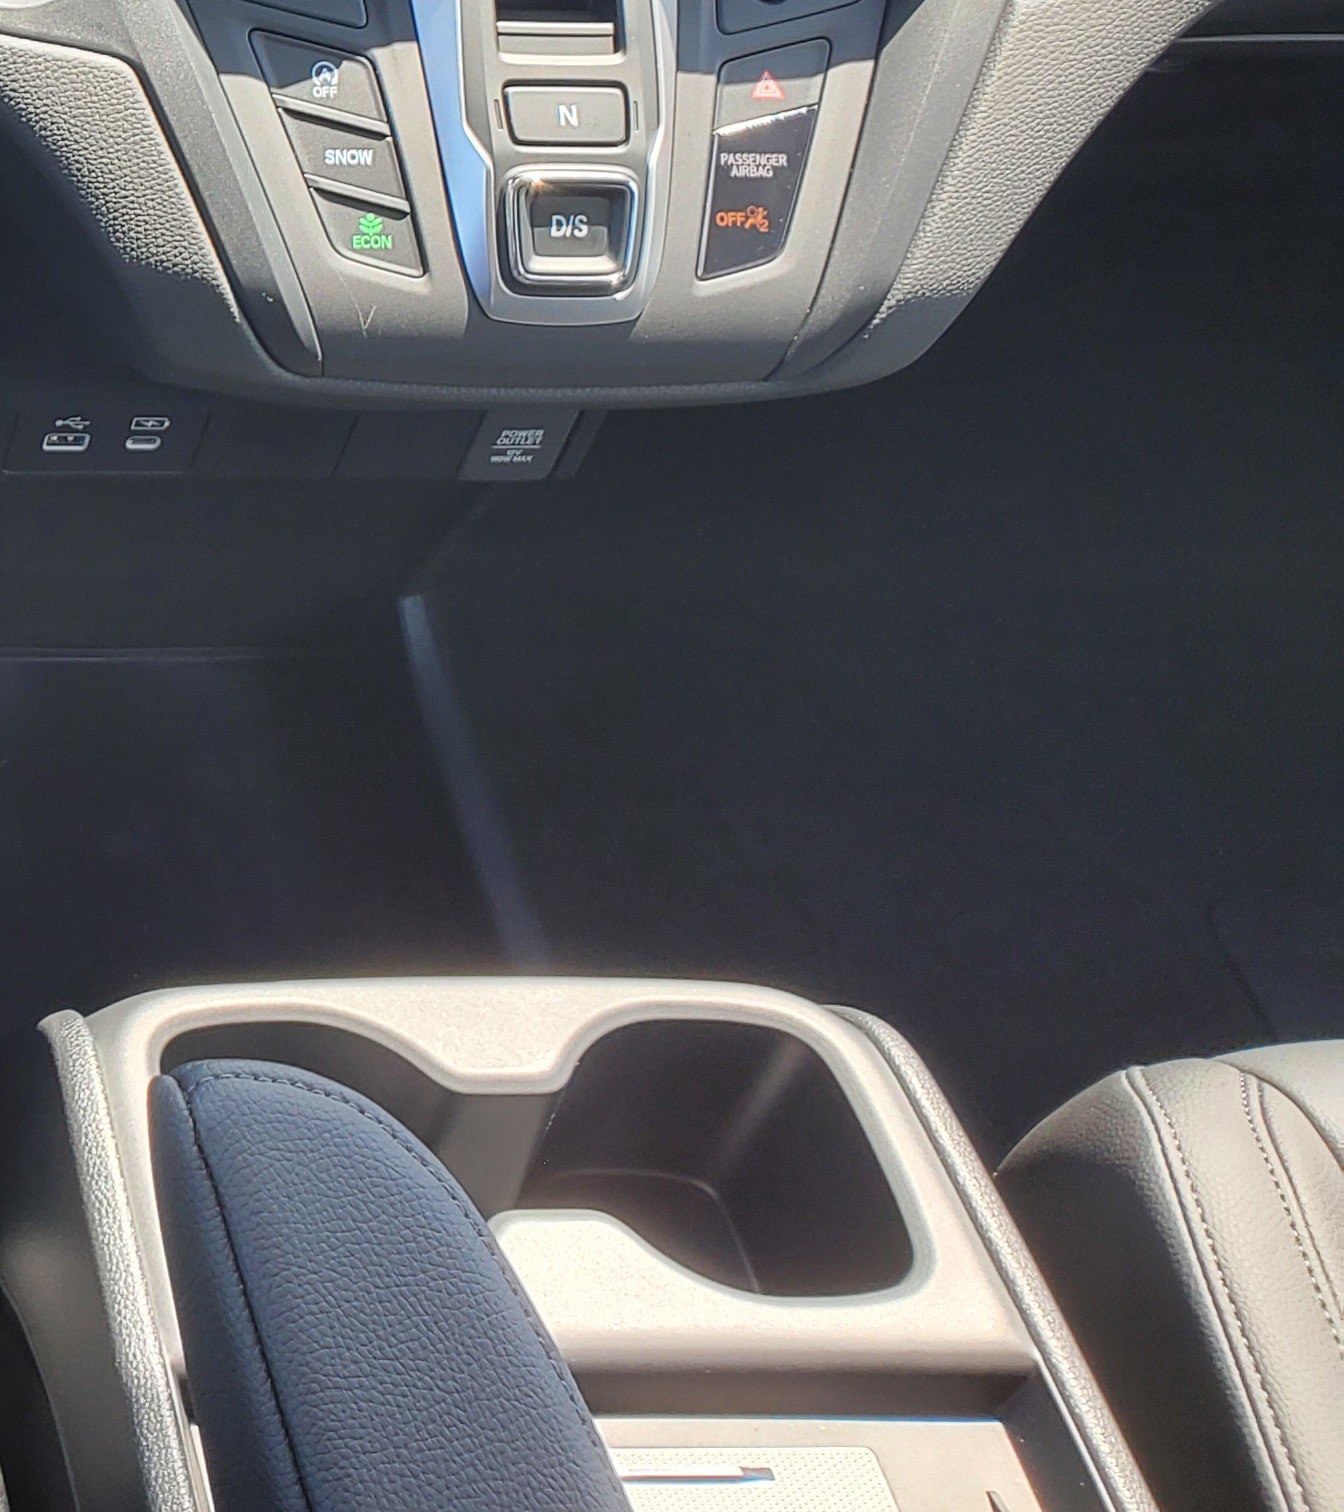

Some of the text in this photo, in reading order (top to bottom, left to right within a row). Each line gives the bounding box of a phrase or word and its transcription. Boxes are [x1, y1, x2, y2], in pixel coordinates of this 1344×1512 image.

[313, 86, 338, 99] OFF
[557, 104, 580, 127] N
[324, 148, 374, 167] SNOW
[720, 152, 789, 169] PASSENGER
[730, 163, 774, 179] AIRBAG
[550, 213, 589, 238] D/S
[716, 210, 746, 228] OFF
[352, 234, 393, 250] ECON
[496, 437, 542, 445] OUTLET
[501, 429, 544, 437] POWER
